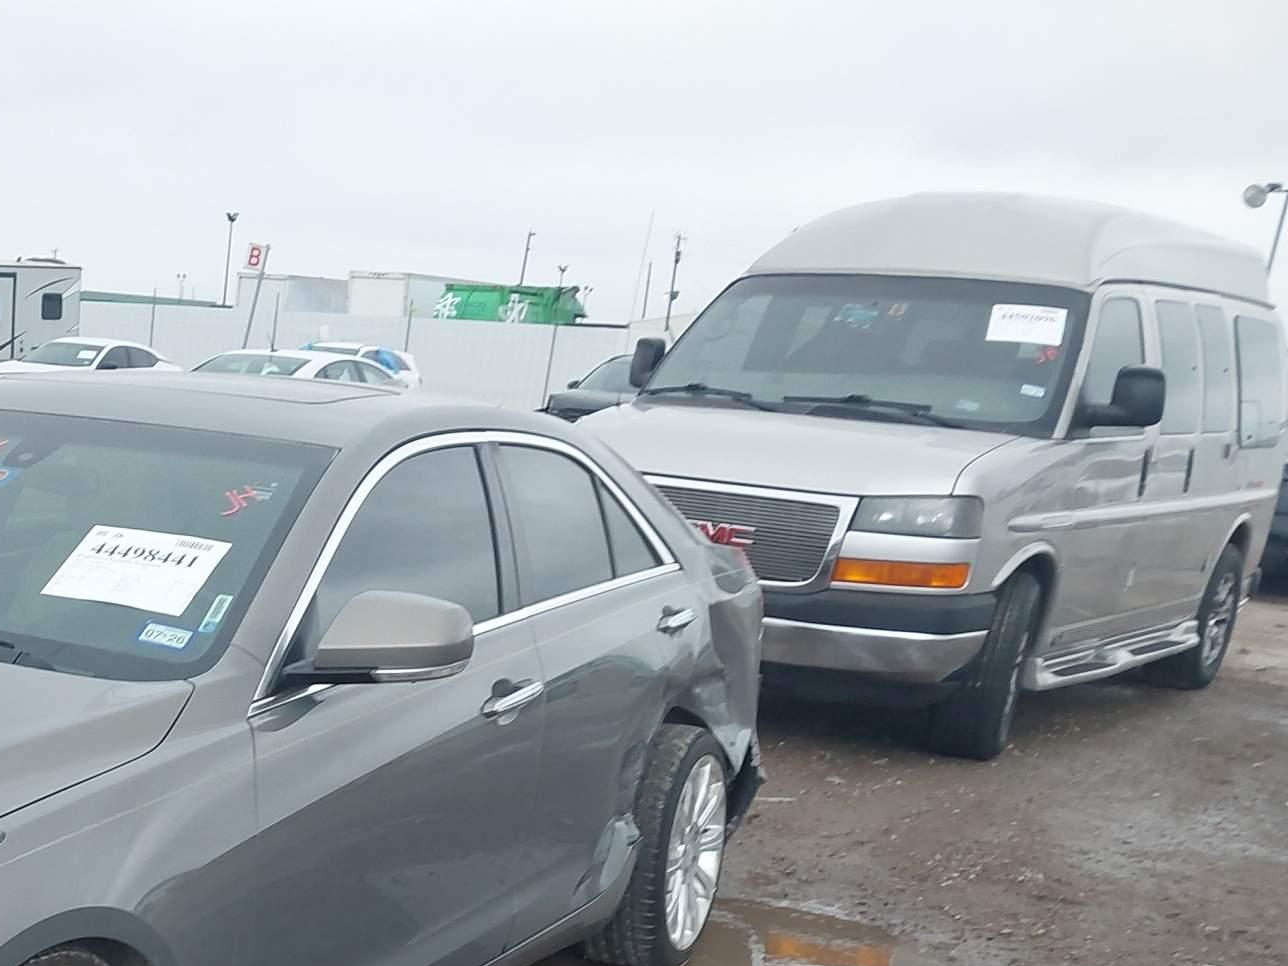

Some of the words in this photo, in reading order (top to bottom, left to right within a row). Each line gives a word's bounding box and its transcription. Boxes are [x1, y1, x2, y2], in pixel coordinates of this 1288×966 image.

[248, 247, 261, 266] B
[688, 520, 756, 547] MC
[91, 543, 200, 568] 44498441
